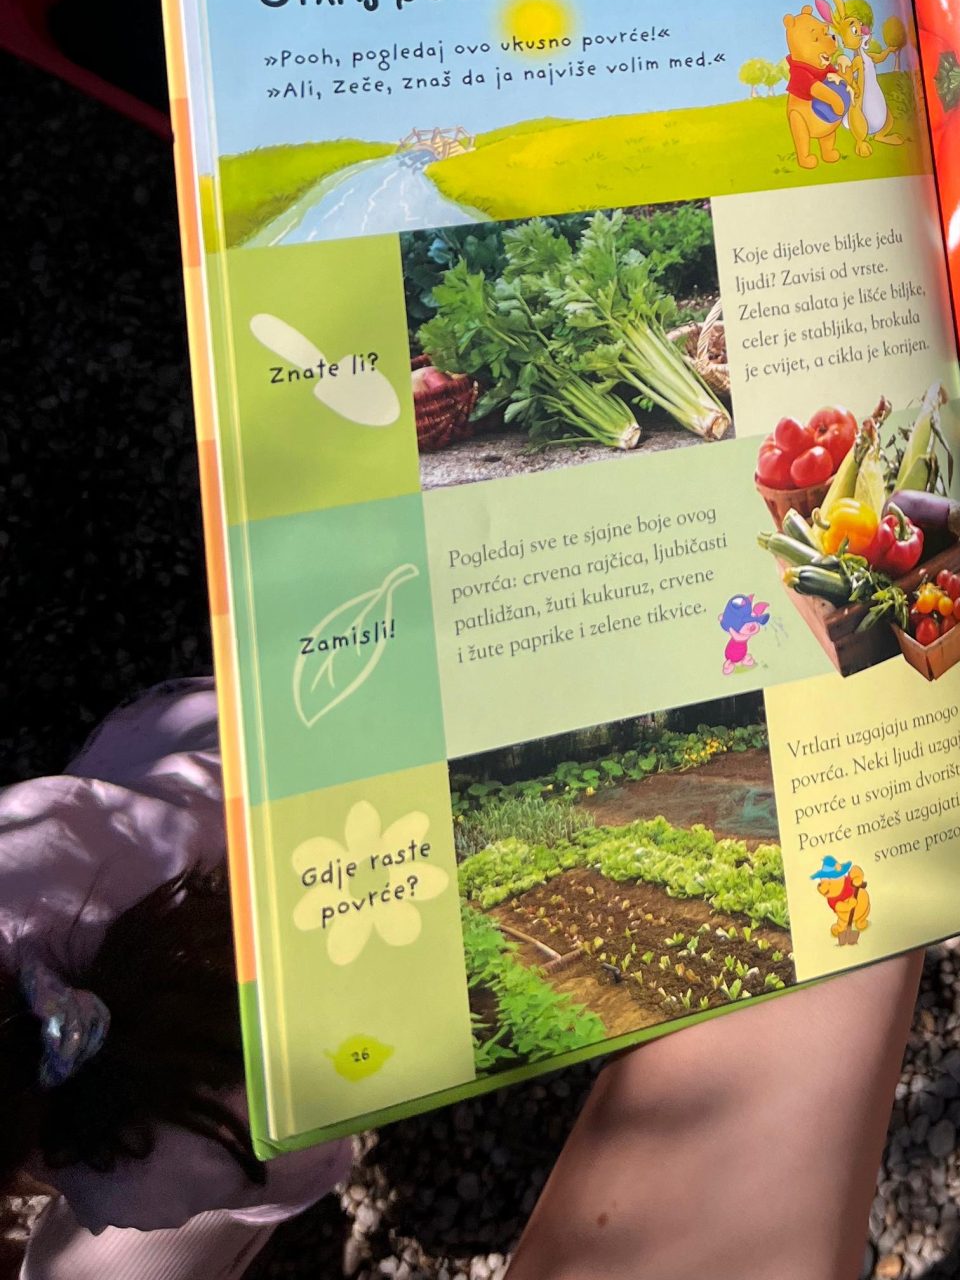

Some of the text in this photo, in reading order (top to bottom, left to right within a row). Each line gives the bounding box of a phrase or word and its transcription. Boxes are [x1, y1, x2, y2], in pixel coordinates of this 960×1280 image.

[264, 27, 670, 70] »Pooh, pogledaj ovo ukusno povrće!«
[267, 52, 726, 100] »Ali, Zeče, znaš da ja najviše volim med.«
[733, 229, 903, 264] Koje dijelove biljke jedu
[736, 262, 888, 295] ljudi? Zavisi od vrste.
[739, 281, 926, 321] Zelena salata je lišće biljke,
[742, 309, 920, 349] celer je stabljika, brokula
[270, 352, 379, 383] Znate li?
[745, 338, 930, 380] je cvijet, a cikla je korijen.
[448, 508, 717, 568] Pogledaj sve te sjajne boje ovog
[451, 533, 728, 604] povrća: crvena rajčica, ljubičasti
[455, 571, 714, 636] patlidžan, žuti kukuruz, crvene
[300, 619, 395, 654] Zamisli!
[457, 602, 707, 663] i žute paprike i zelene tikvice.
[787, 705, 959, 758] Vrtlari uzgajaju mnogo
[791, 762, 848, 794] povrća.
[853, 752, 889, 774] Neki
[893, 741, 924, 767] ljudi
[795, 794, 846, 824] povrće
[851, 793, 860, 805] u
[865, 780, 911, 802] svojim
[798, 825, 852, 851] Povrće
[857, 810, 901, 836] možeš
[905, 795, 960, 822] uzgajati
[302, 839, 430, 890] Gdje raste
[874, 839, 920, 862] svome
[322, 875, 419, 929] povrće?
[351, 1047, 370, 1063] 26
